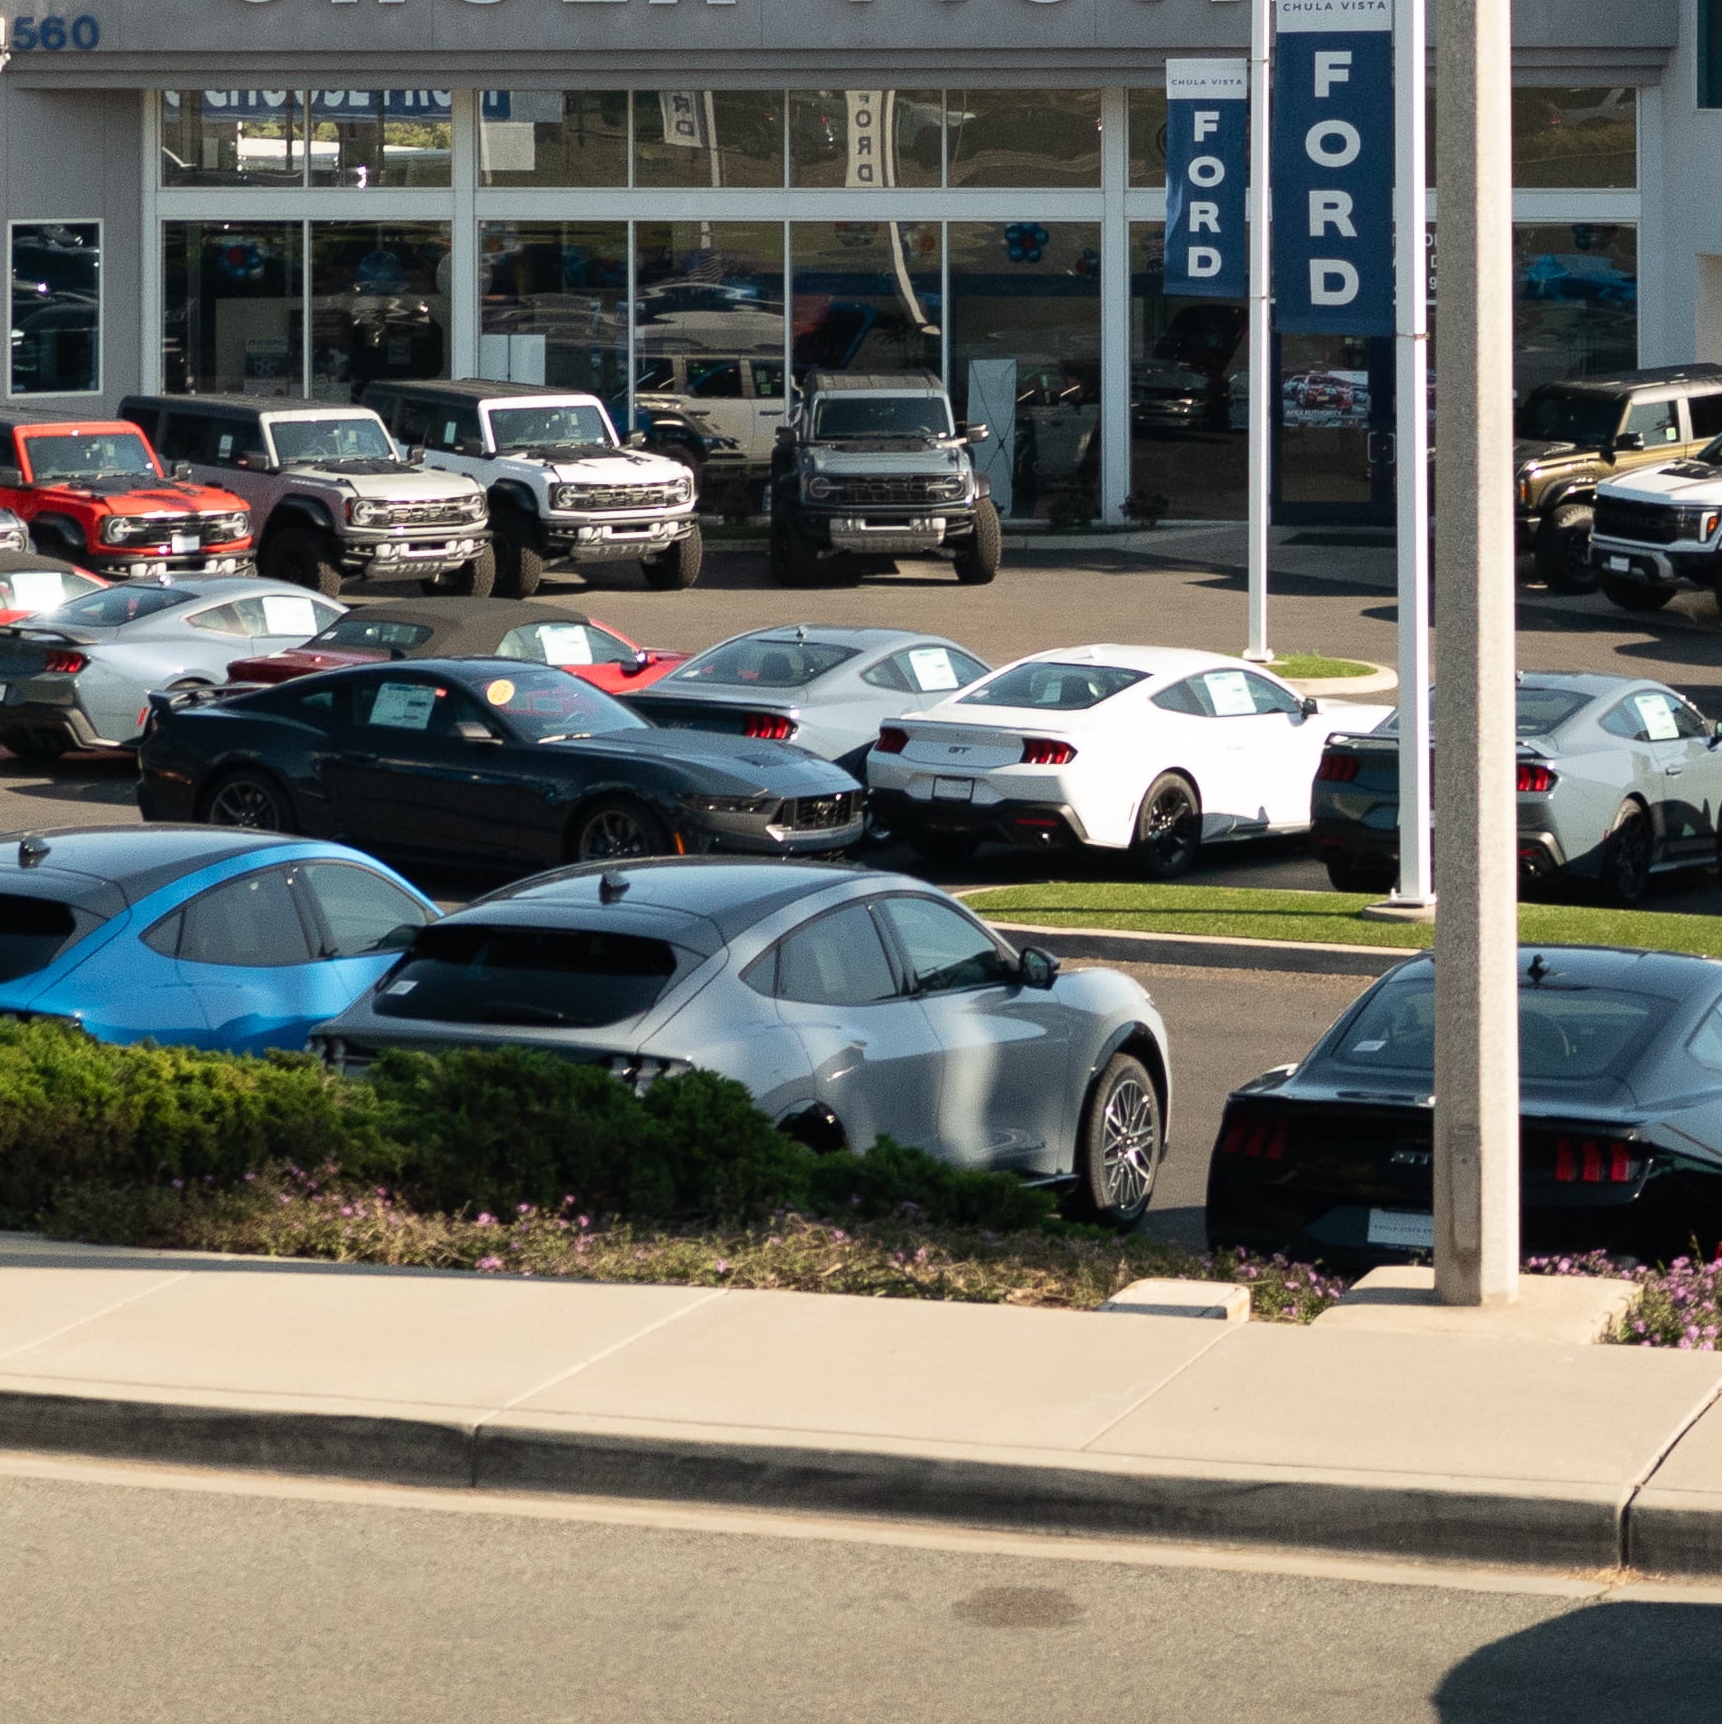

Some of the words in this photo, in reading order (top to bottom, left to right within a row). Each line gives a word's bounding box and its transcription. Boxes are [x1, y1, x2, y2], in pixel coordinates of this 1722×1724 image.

[12, 15, 100, 50] 560
[1283, 3, 1333, 12] CHULA
[1340, 1, 1386, 10] VISTA
[1187, 111, 1226, 278] FORD
[1305, 51, 1361, 306] FORD
